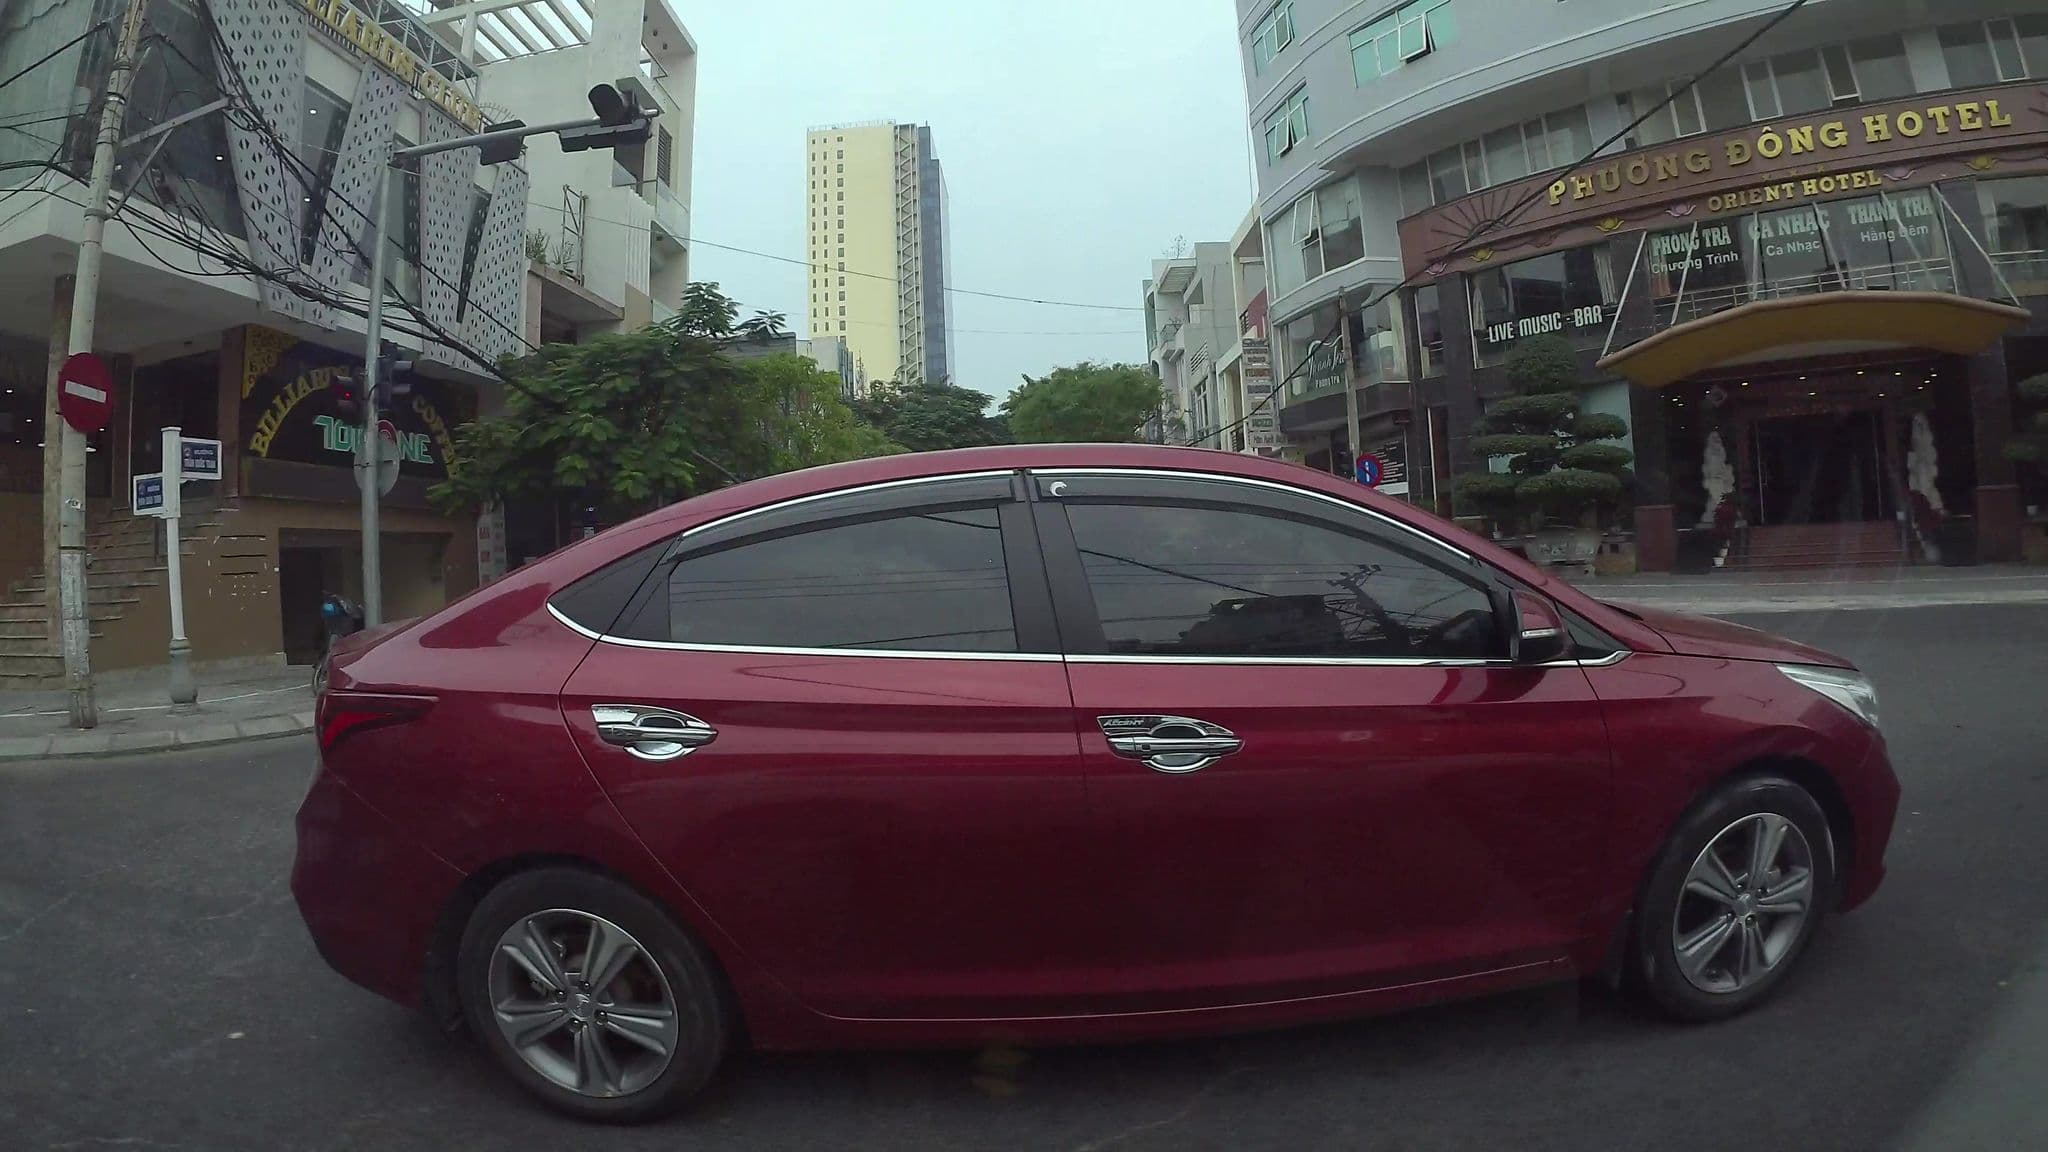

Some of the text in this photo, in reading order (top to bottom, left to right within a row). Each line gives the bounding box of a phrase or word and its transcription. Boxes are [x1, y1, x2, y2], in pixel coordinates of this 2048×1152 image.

[1548, 99, 2012, 206] PHƯƠNG ĐÔNG HOTEL
[1708, 169, 1882, 212] ORIENT HOTEL
[1766, 240, 1821, 257] Ca Nhạc
[1488, 321, 1515, 343] LIVE
[1519, 311, 1562, 337] MUSIC
[1573, 305, 1603, 327] BAR
